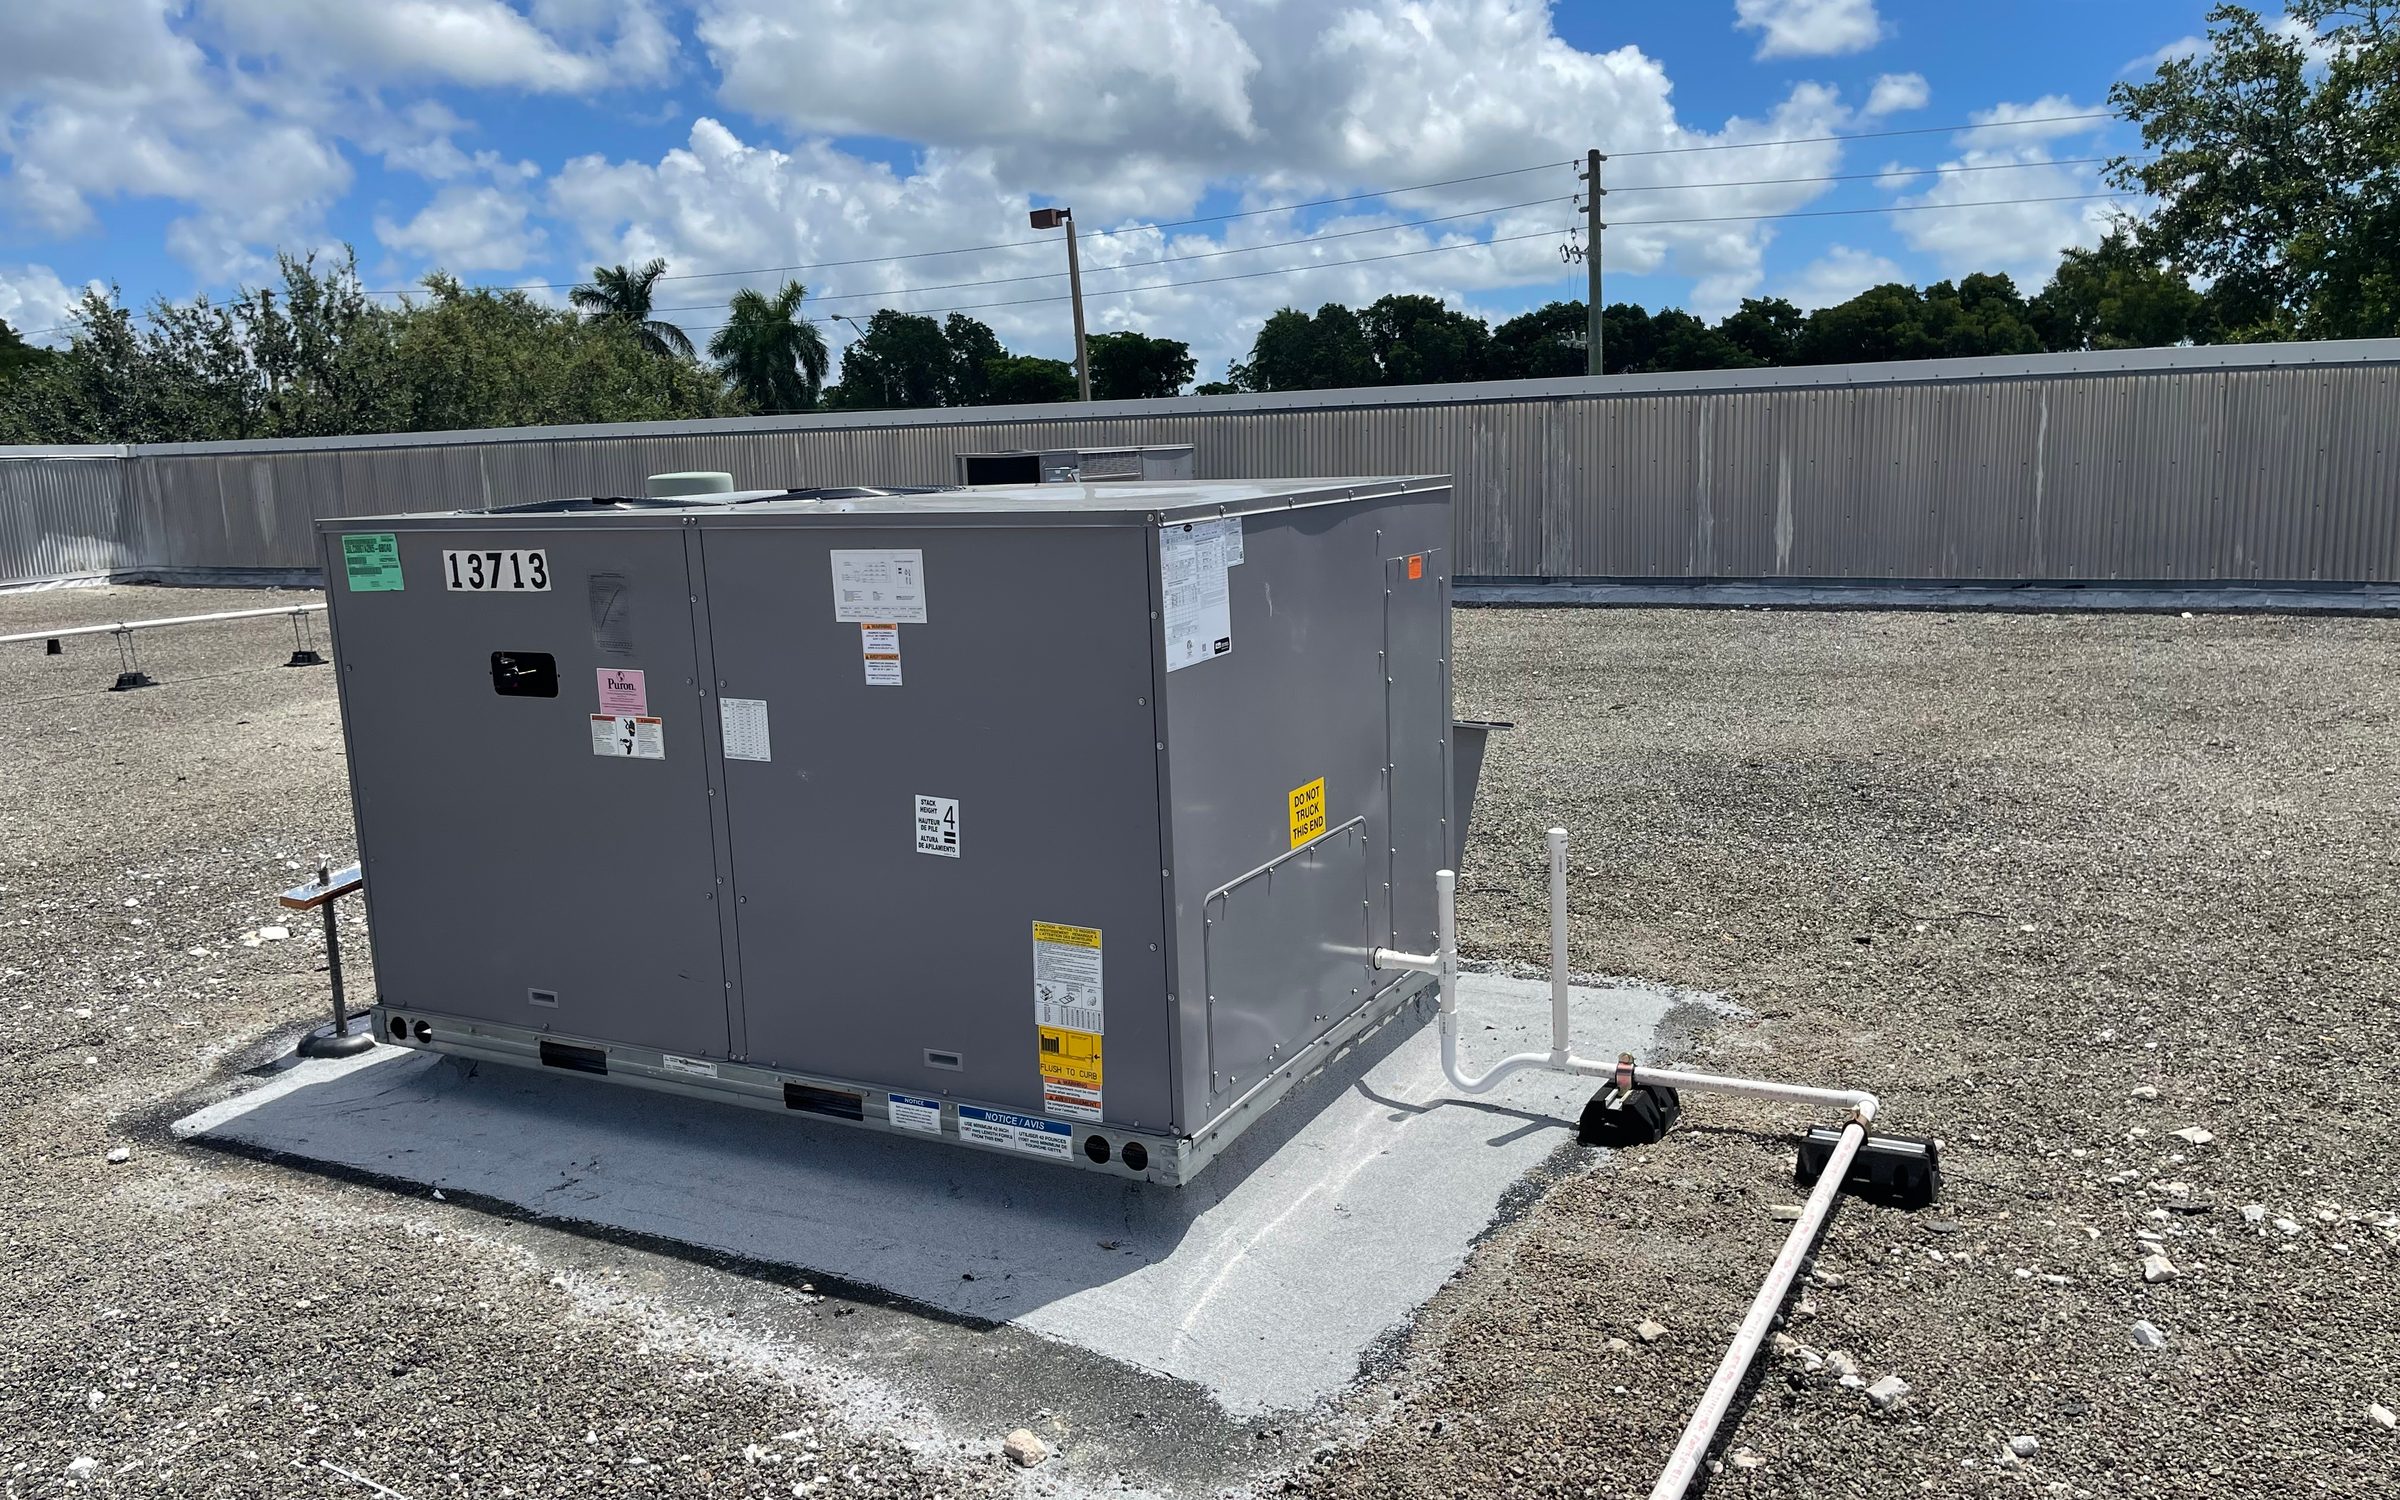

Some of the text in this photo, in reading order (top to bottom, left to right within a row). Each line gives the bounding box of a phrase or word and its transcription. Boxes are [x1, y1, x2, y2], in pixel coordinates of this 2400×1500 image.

[449, 552, 547, 589] 13713
[607, 678, 635, 691] Puron
[1294, 786, 1320, 808] DO NOT
[920, 799, 936, 807] STACK
[919, 807, 938, 815] HEIGHT
[1296, 802, 1320, 822] TRUCK
[918, 818, 941, 826] HAUTEUR
[943, 805, 956, 830] 4
[1293, 816, 1324, 840] THIS END
[920, 835, 939, 844] ALTURA
[1040, 1063, 1098, 1080] FLUSH TO CURB
[904, 1097, 925, 1106] NOTICE
[985, 1111, 1018, 1125] NOTICE
[1023, 1119, 1045, 1130] AVIS
[973, 1122, 993, 1131] MINIMUM
[999, 1132, 1014, 1140] FORKS
[1018, 1131, 1039, 1139] UTILISER
[1040, 1140, 1061, 1148] MINIMUM
